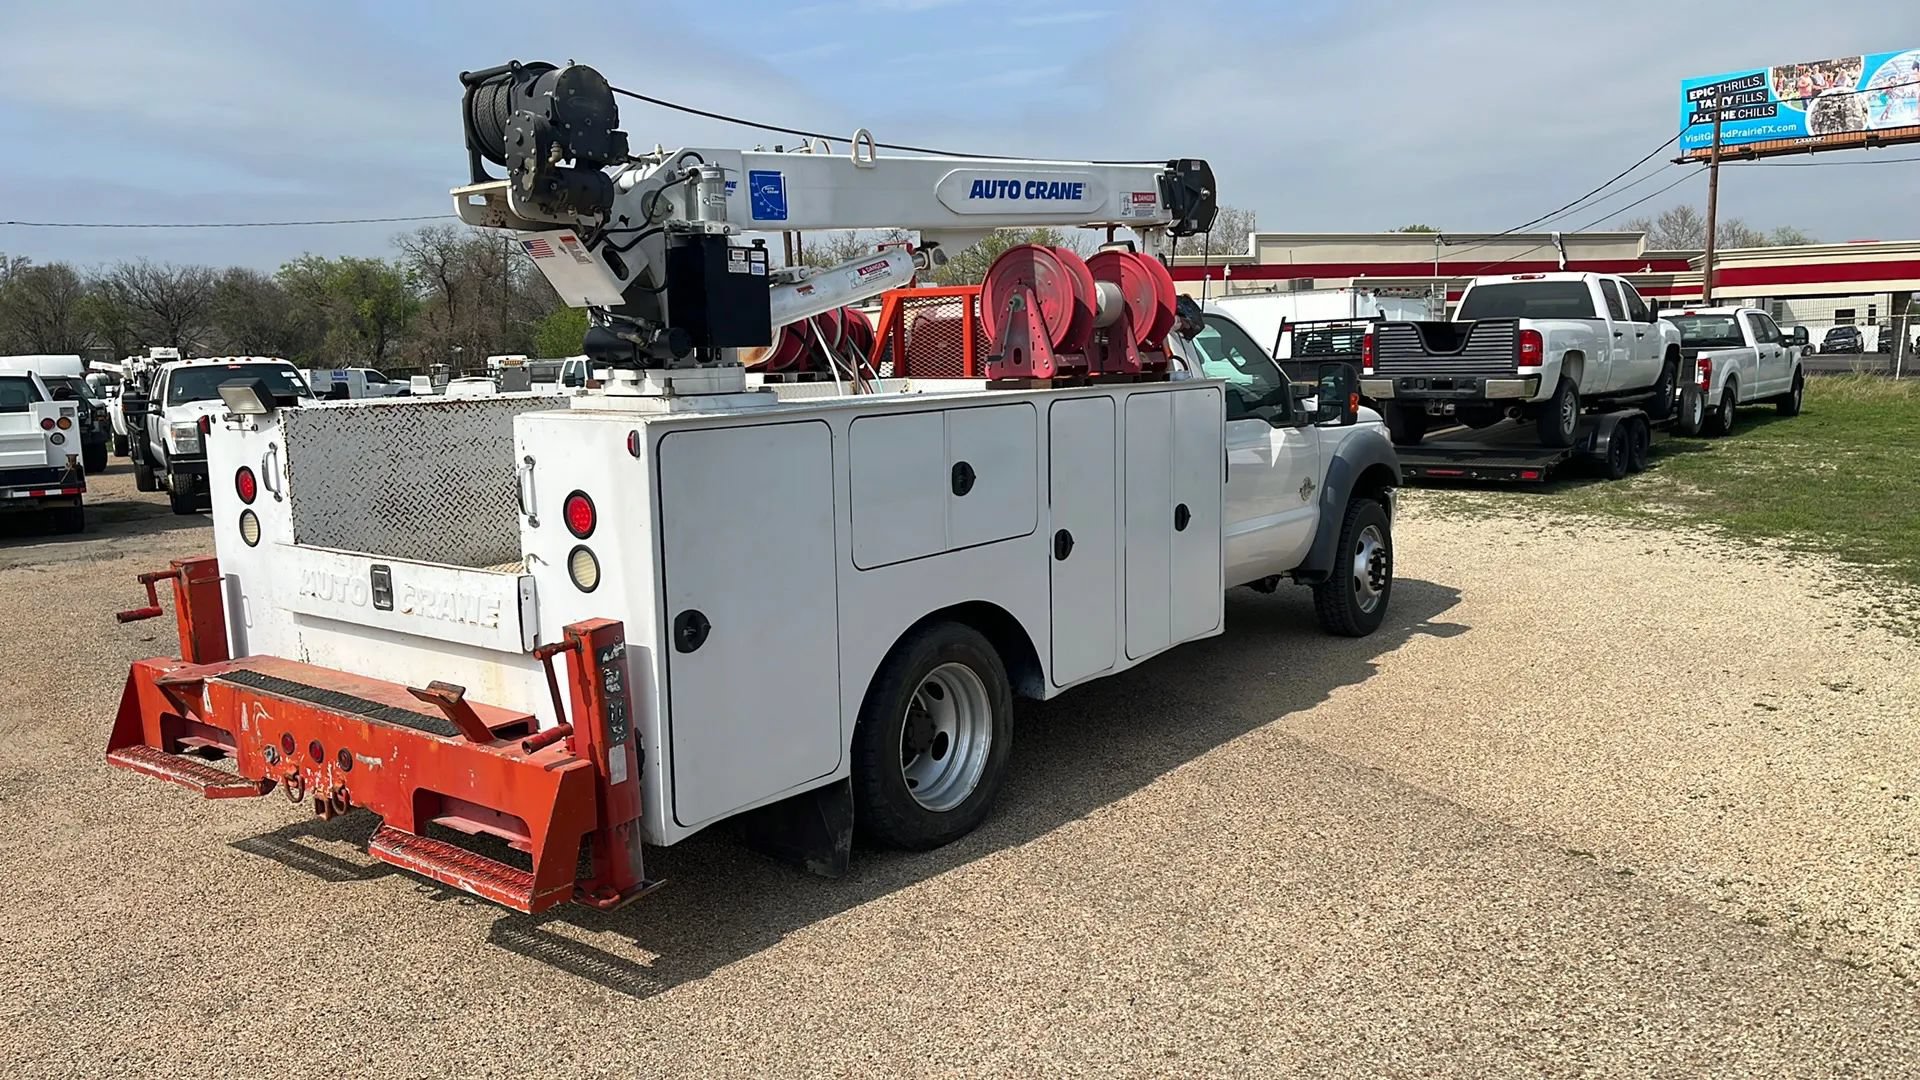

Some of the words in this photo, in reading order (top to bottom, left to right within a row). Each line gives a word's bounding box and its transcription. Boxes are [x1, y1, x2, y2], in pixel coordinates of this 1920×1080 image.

[1689, 87, 1715, 100] EPIC
[1717, 76, 1762, 93] THRILLS,
[1735, 91, 1766, 104] FILLS,
[1714, 110, 1736, 120] HE
[1737, 106, 1775, 119] CHILLS
[969, 179, 1021, 200] AUTO
[1024, 180, 1083, 200] CRANE
[299, 569, 369, 607] AUTO
[402, 582, 501, 629] CRANE
